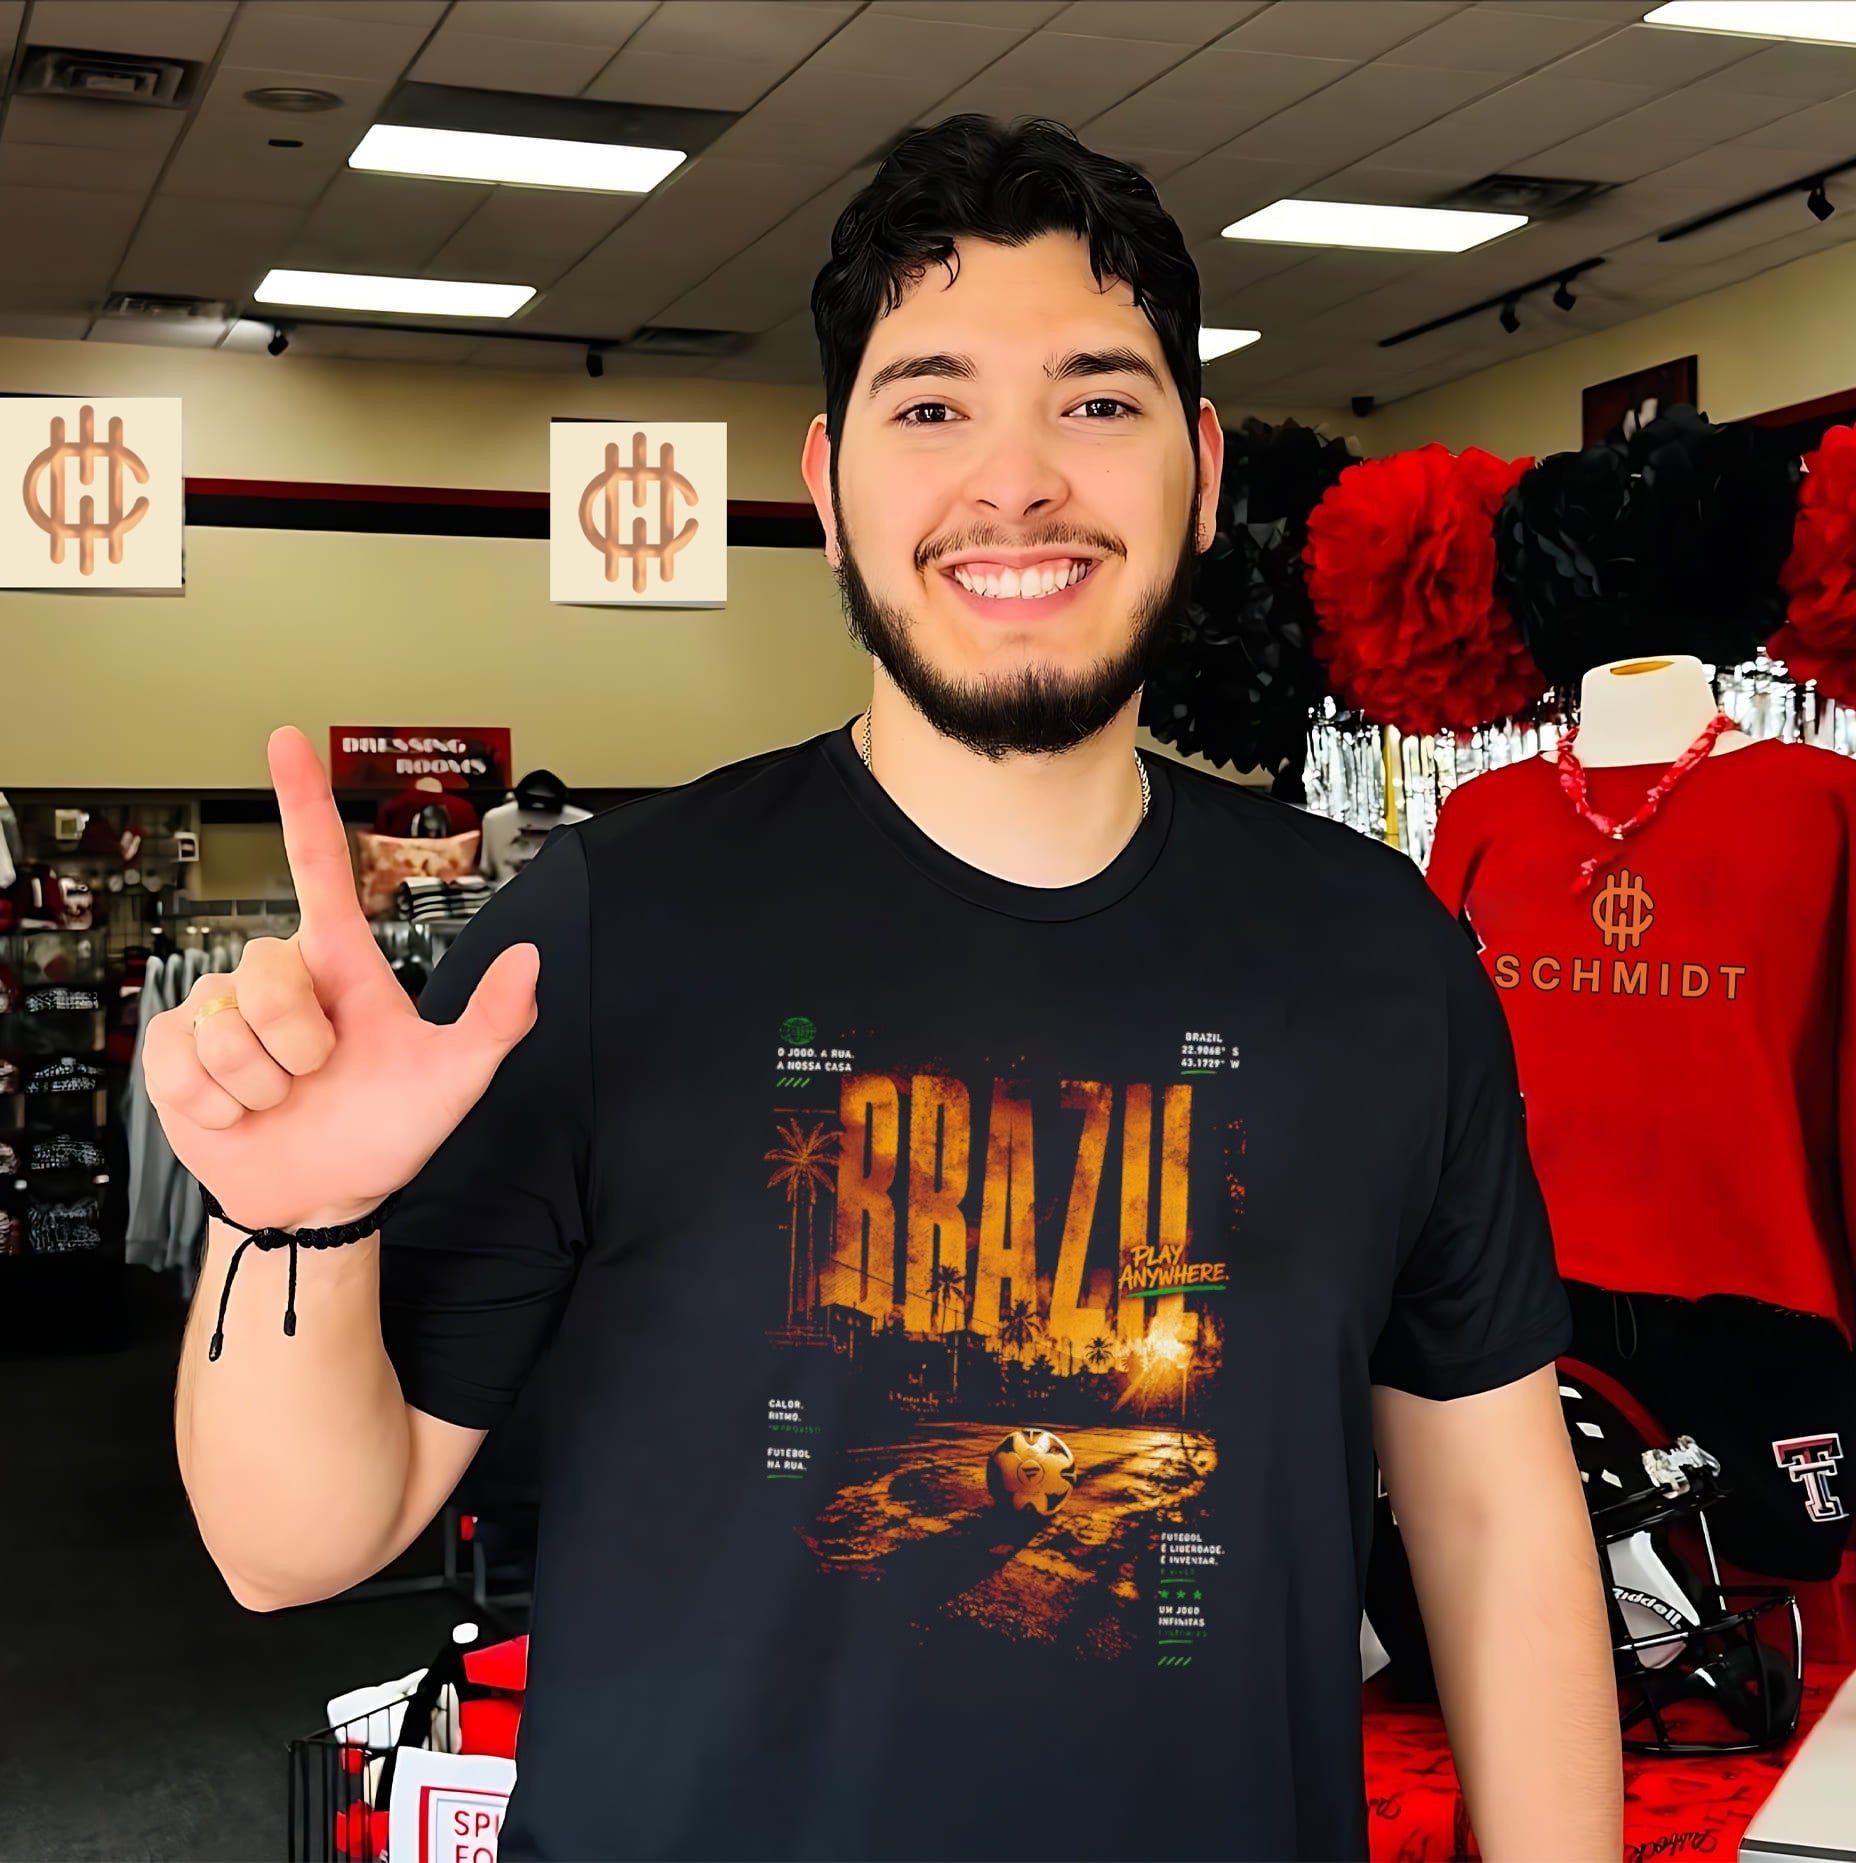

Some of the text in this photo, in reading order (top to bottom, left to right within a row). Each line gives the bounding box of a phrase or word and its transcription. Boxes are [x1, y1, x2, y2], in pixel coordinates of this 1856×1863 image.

[396, 758, 487, 775] ROOMS
[1493, 953, 1747, 1000] SCHMIDT
[1185, 1031, 1223, 1043] BRAZIL
[777, 1047, 785, 1057] O
[820, 1050, 828, 1058] A
[831, 1049, 855, 1059] RUA.
[1232, 1046, 1239, 1057] S
[776, 1061, 852, 1072] A NOSSA CASA
[1230, 1059, 1240, 1069] W
[1130, 1244, 1184, 1268] PLAY
[1118, 1262, 1230, 1291] ANYWHERE.
[768, 1398, 804, 1410] CALOR.
[768, 1410, 802, 1422] RITMO.
[766, 1447, 811, 1459] FUTEBOL
[766, 1460, 807, 1471] NA RUA.
[1169, 1555, 1219, 1566] INVENTAR.
[1158, 1617, 1205, 1627] INFINITAS
